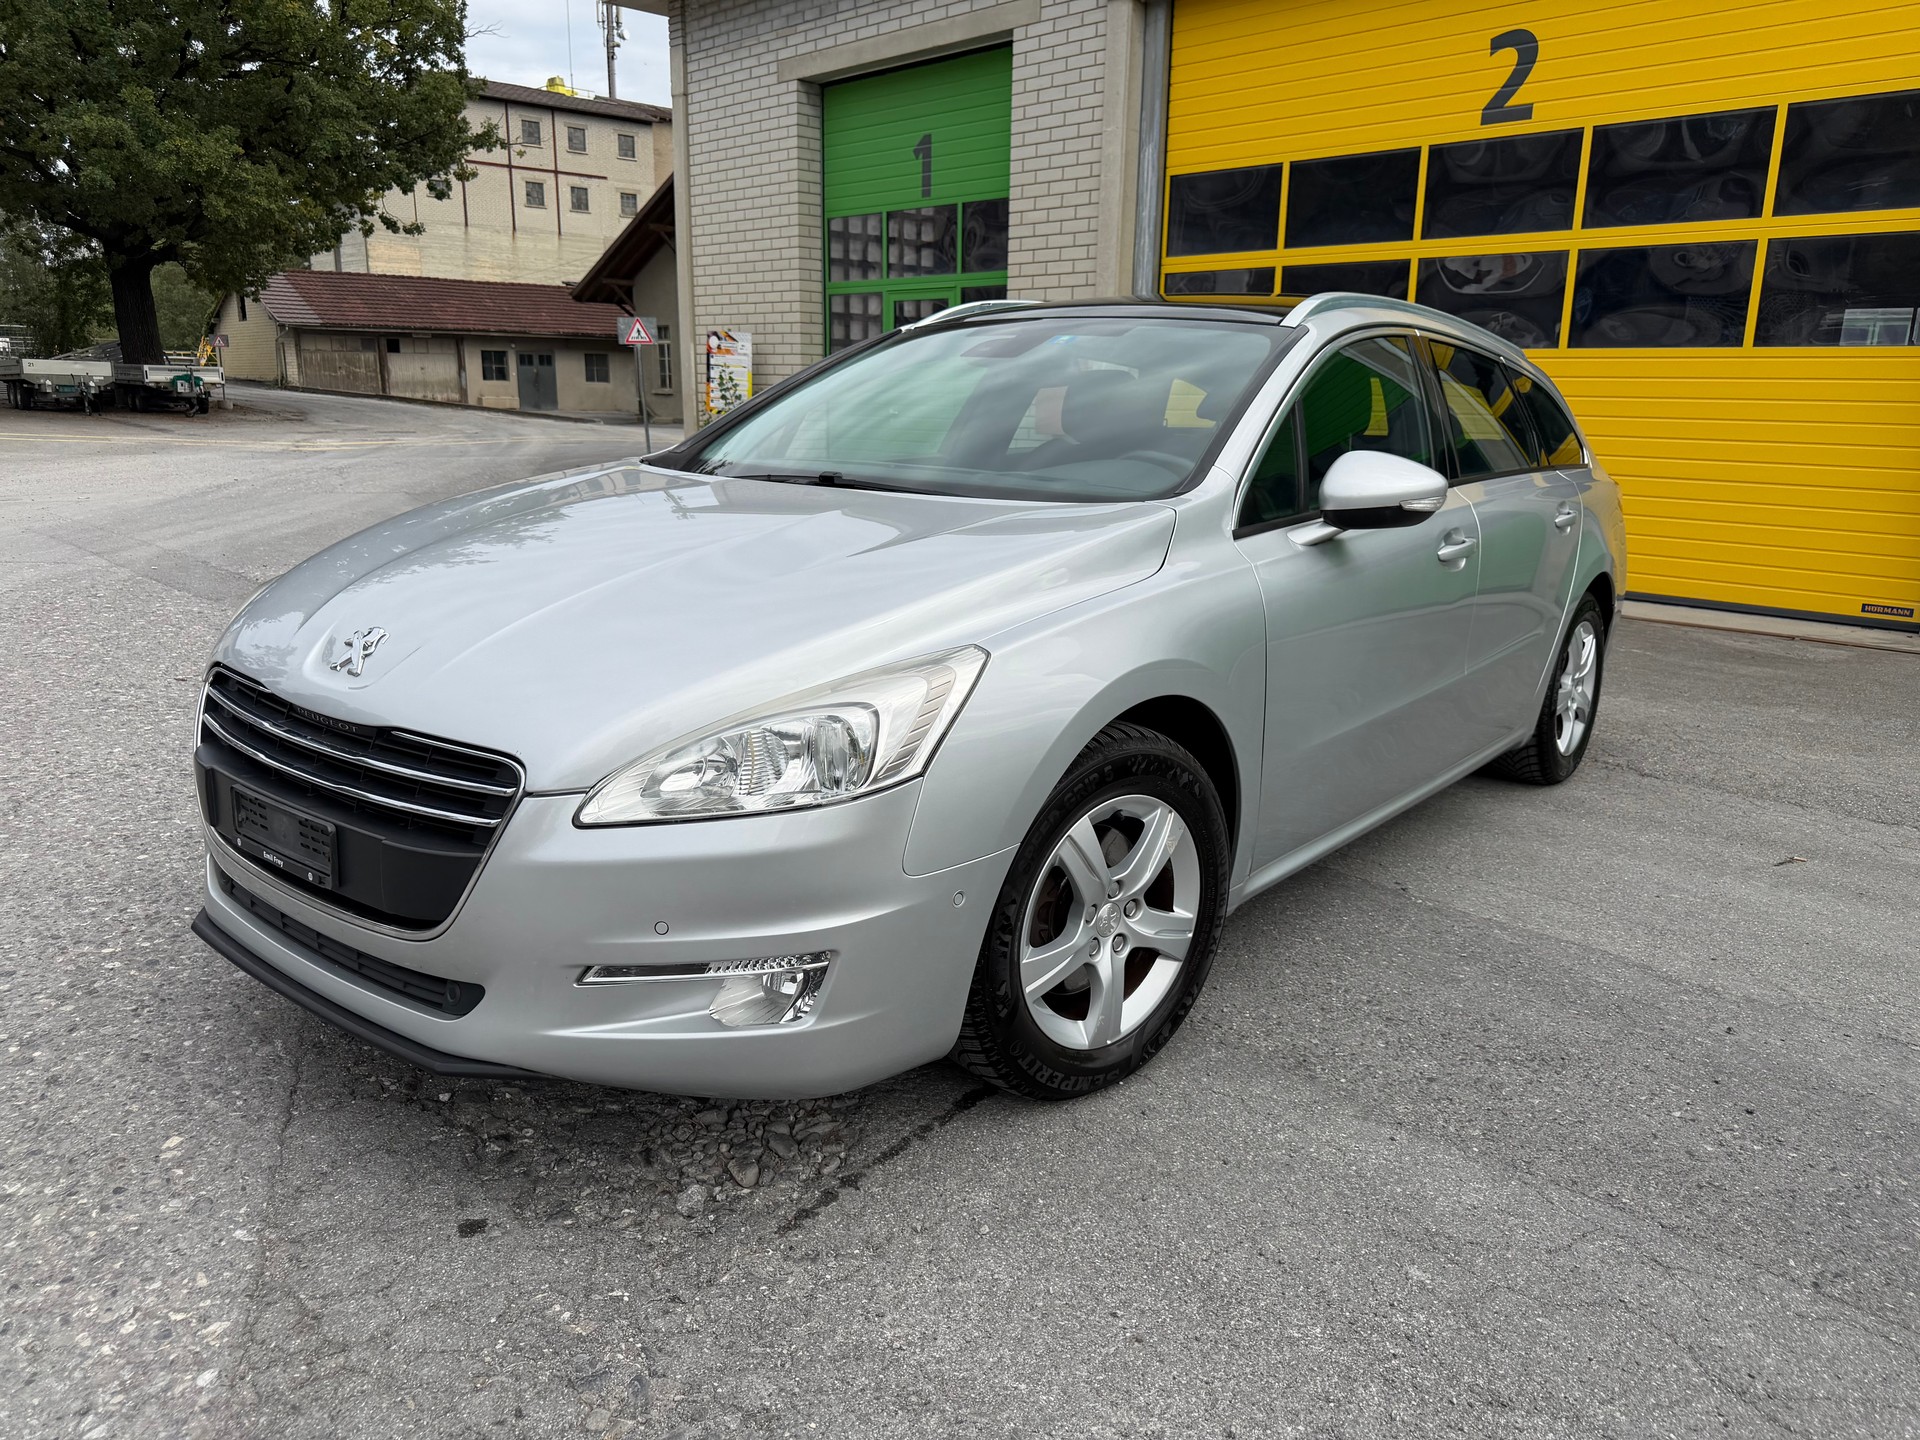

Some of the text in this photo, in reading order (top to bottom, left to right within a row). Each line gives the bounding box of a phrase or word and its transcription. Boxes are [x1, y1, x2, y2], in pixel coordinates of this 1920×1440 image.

[1480, 29, 1539, 126] 2
[912, 134, 932, 198] 1
[297, 707, 358, 732] PEUGEOT
[1104, 764, 1114, 781] 5
[1017, 1054, 1120, 1091] SEMPERIT
